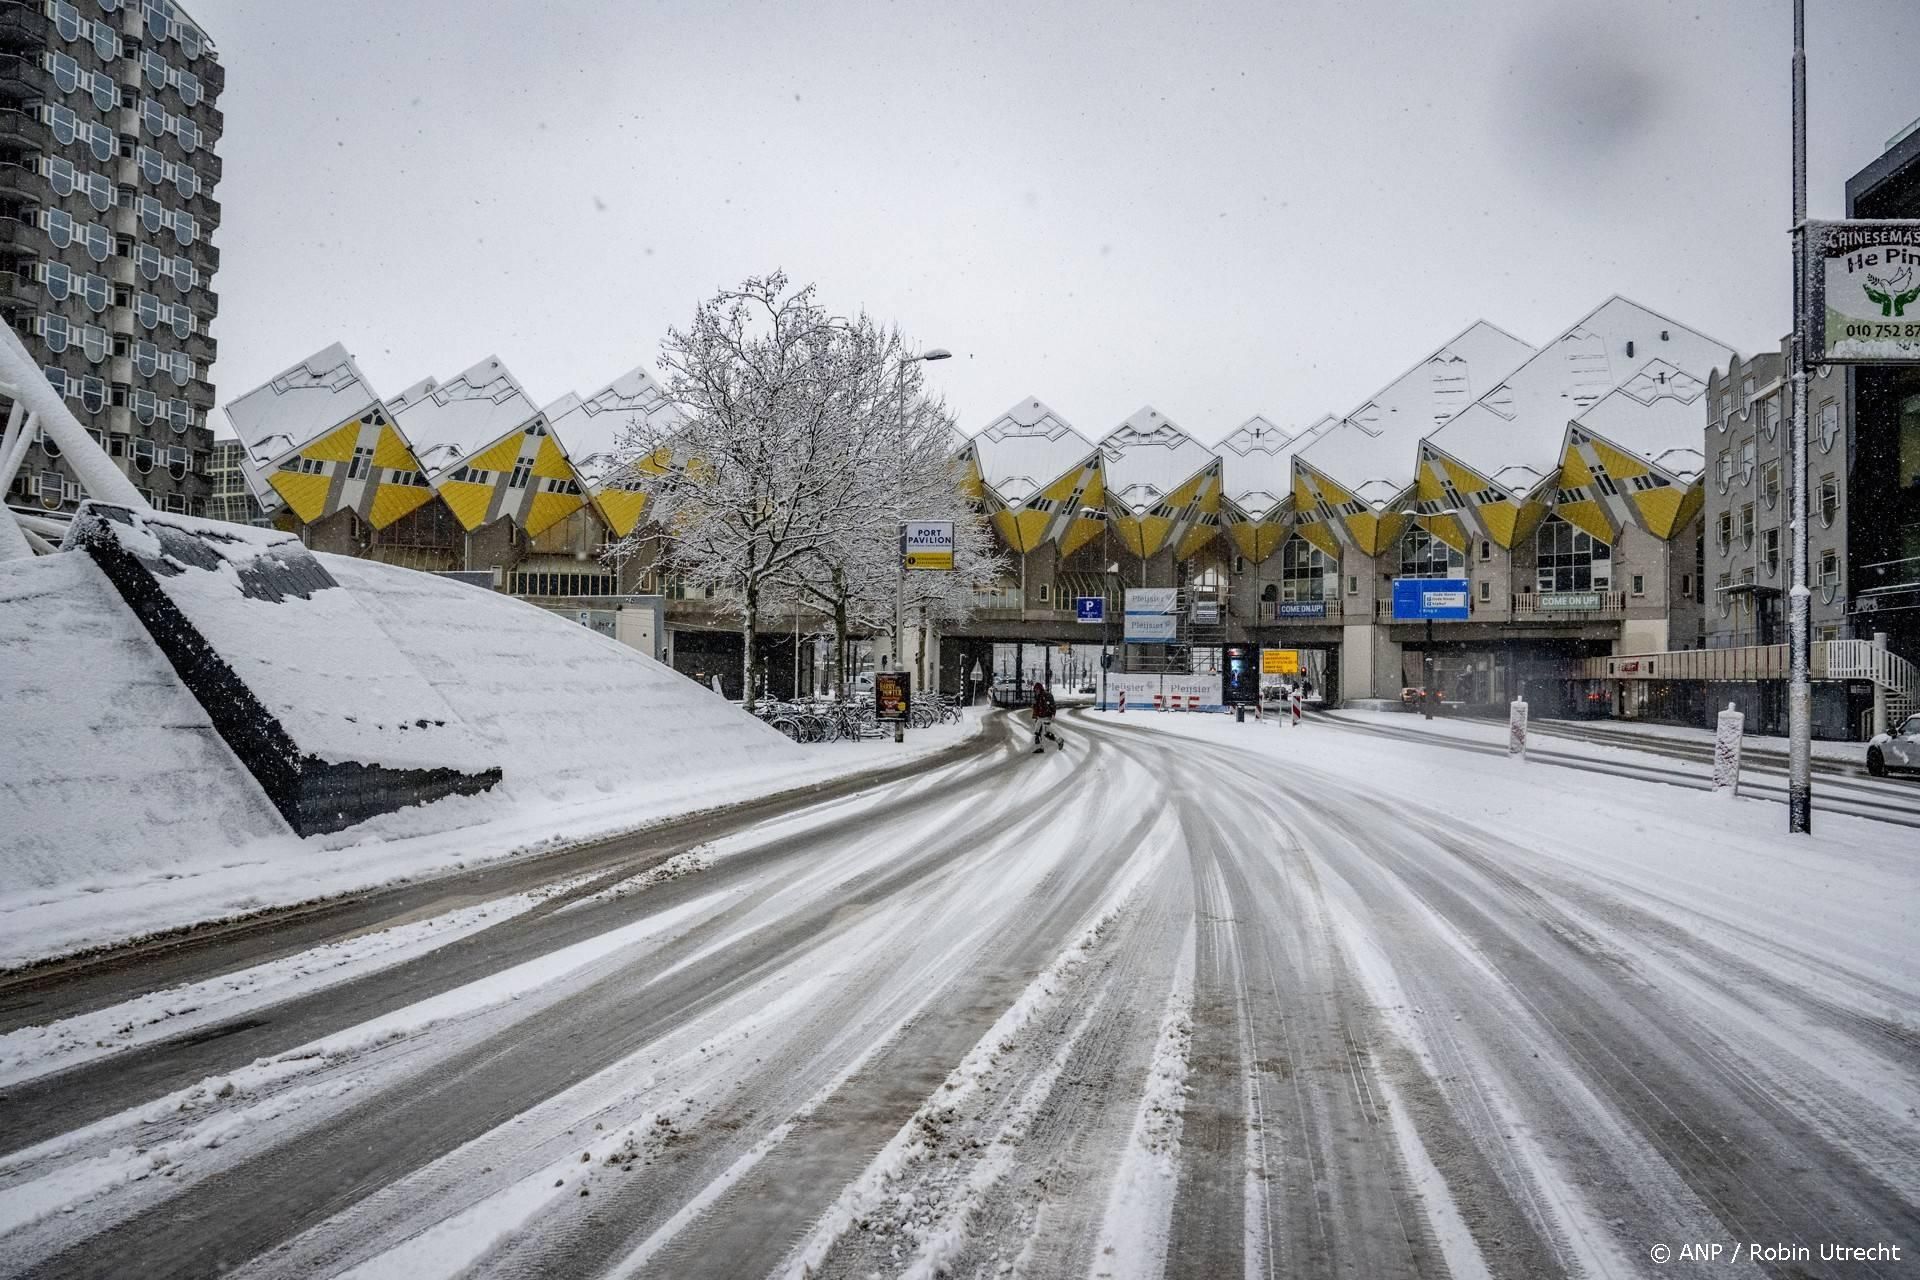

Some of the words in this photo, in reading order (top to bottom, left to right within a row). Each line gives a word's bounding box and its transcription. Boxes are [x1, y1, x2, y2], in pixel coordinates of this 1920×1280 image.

[1847, 253, 1878, 274] He
[1846, 325, 1871, 337] 010
[1875, 325, 1900, 338] 752
[917, 529, 942, 537] PORT
[1086, 601, 1094, 611] P
[1541, 597, 1567, 606] COME
[1568, 596, 1581, 605] ON
[1583, 596, 1599, 605] UP!
[1281, 605, 1300, 613] COME
